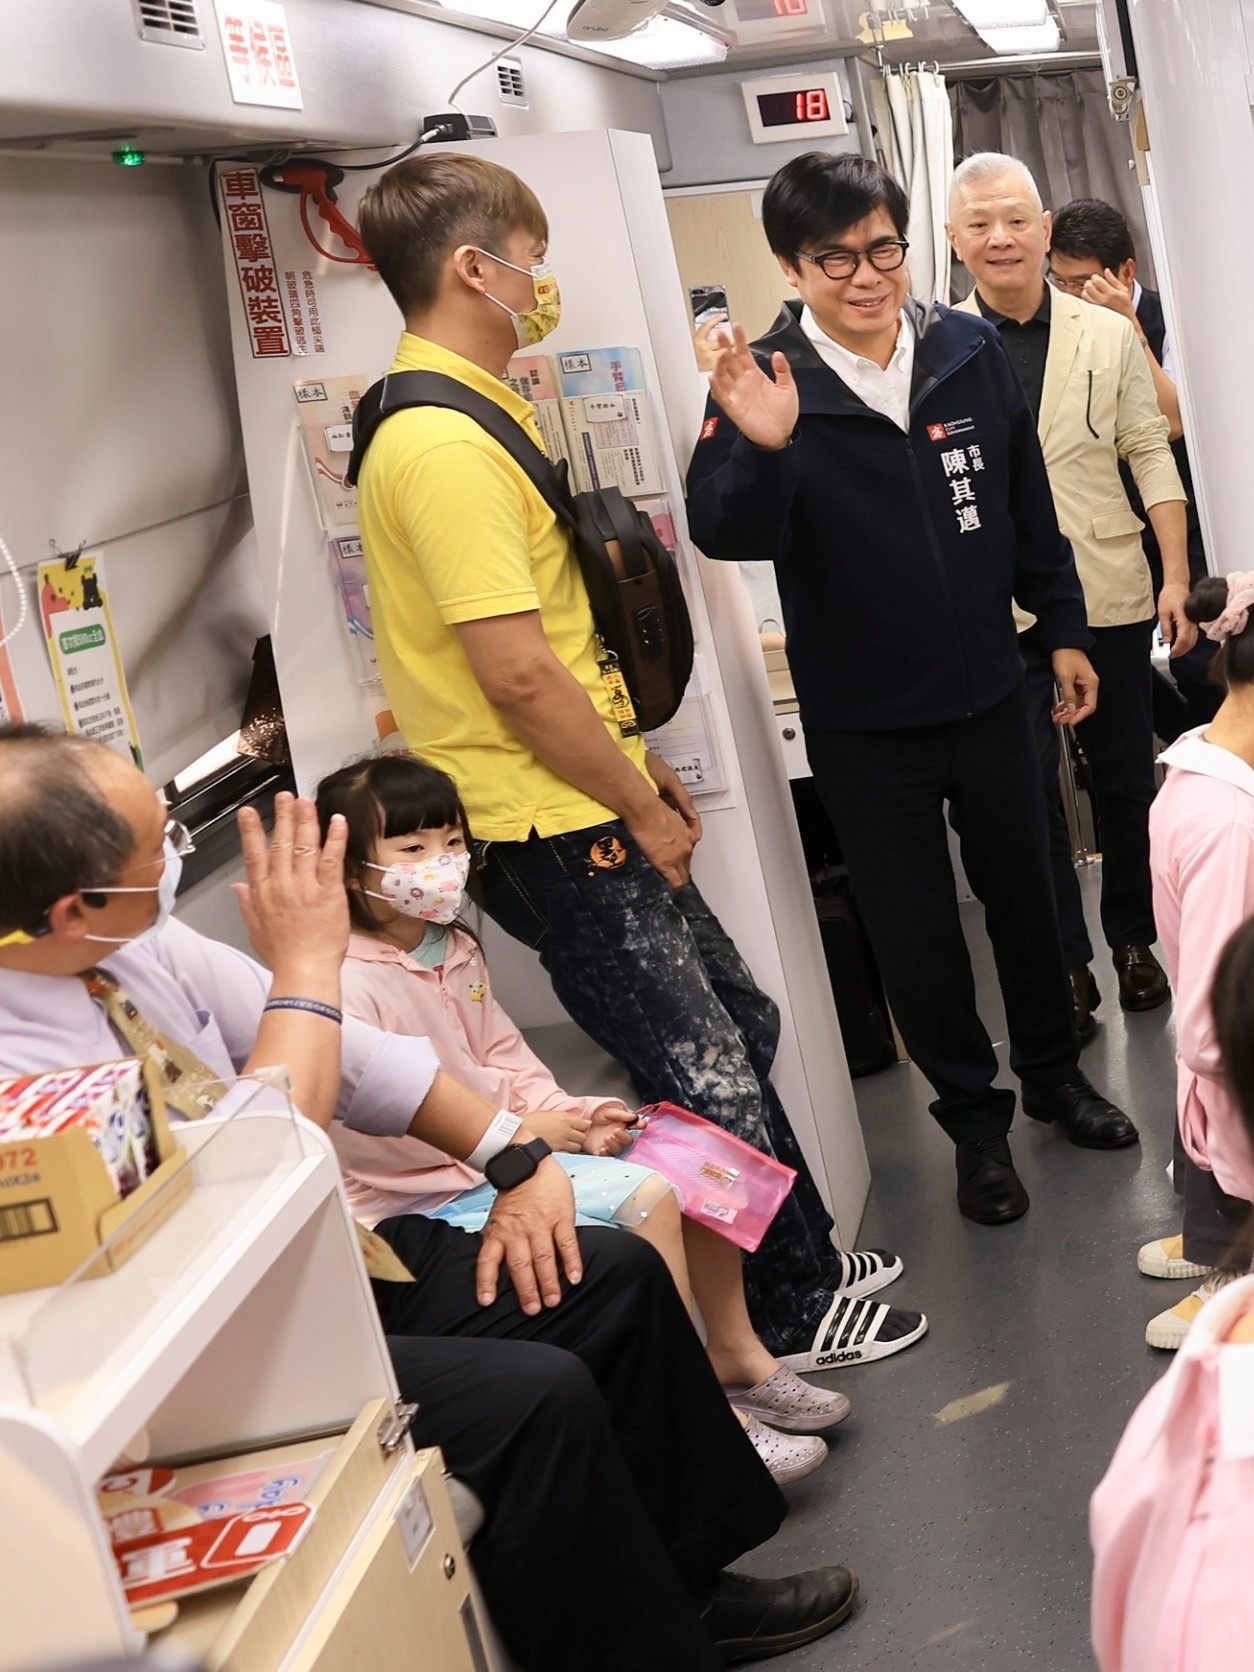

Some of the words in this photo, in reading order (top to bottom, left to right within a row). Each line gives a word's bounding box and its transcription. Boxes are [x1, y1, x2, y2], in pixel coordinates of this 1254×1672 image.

[224, 15, 296, 88] 等候區
[796, 90, 828, 120] 18
[223, 171, 289, 356] 車窗擊破裝置
[563, 359, 589, 371] 樣本
[297, 387, 325, 400] 樣本
[966, 444, 986, 472] 市長
[940, 448, 982, 534] 陳其邁
[816, 1350, 862, 1366] adidas
